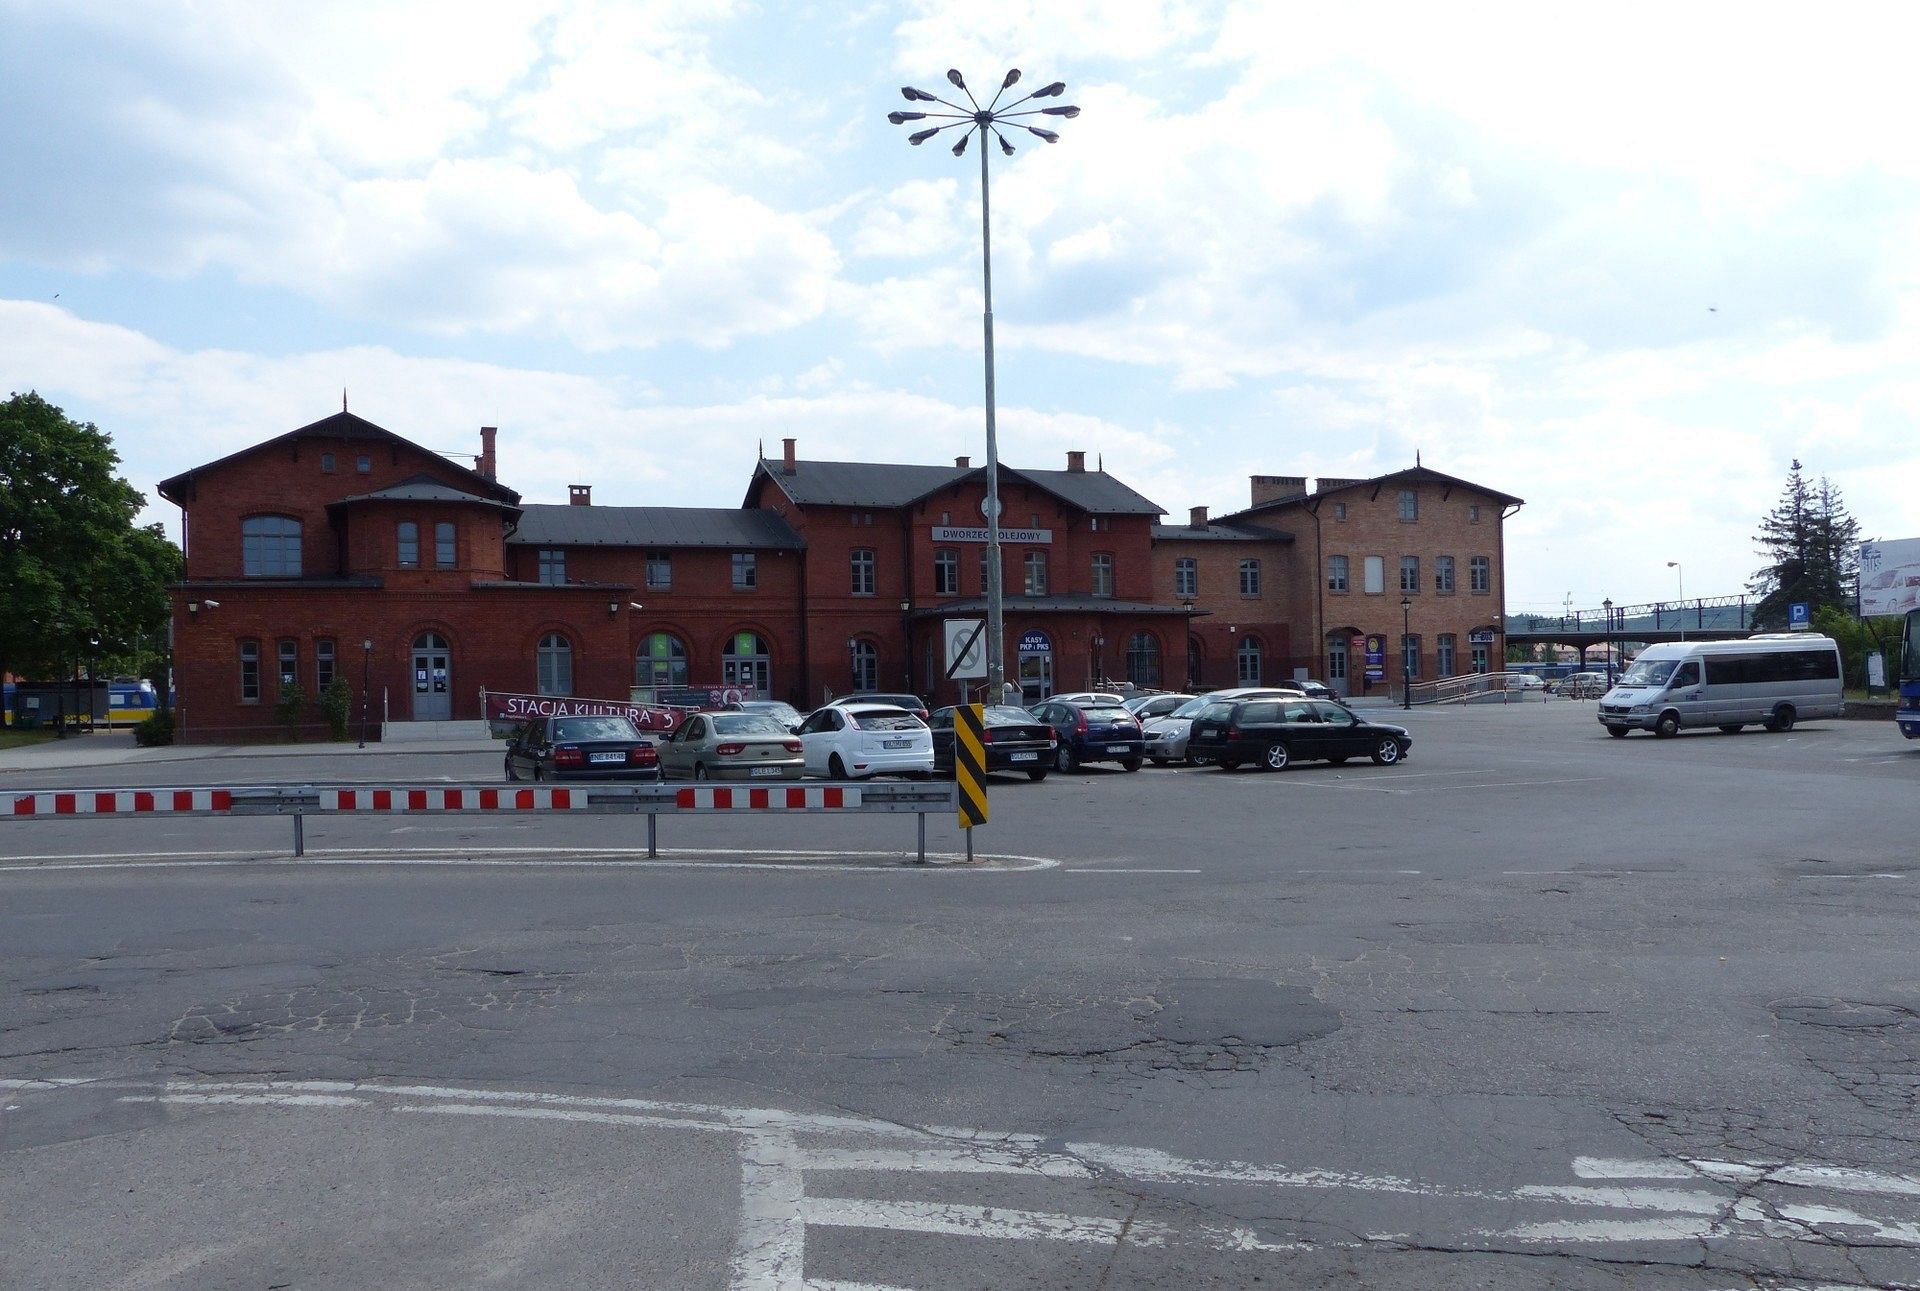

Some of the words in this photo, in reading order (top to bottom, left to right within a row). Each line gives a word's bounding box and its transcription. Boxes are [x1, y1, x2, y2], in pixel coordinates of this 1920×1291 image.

[943, 530, 989, 539] DWORZEC
[998, 531, 1041, 540] OLEJOWY
[1793, 605, 1805, 621] P
[507, 698, 569, 717] STACJA
